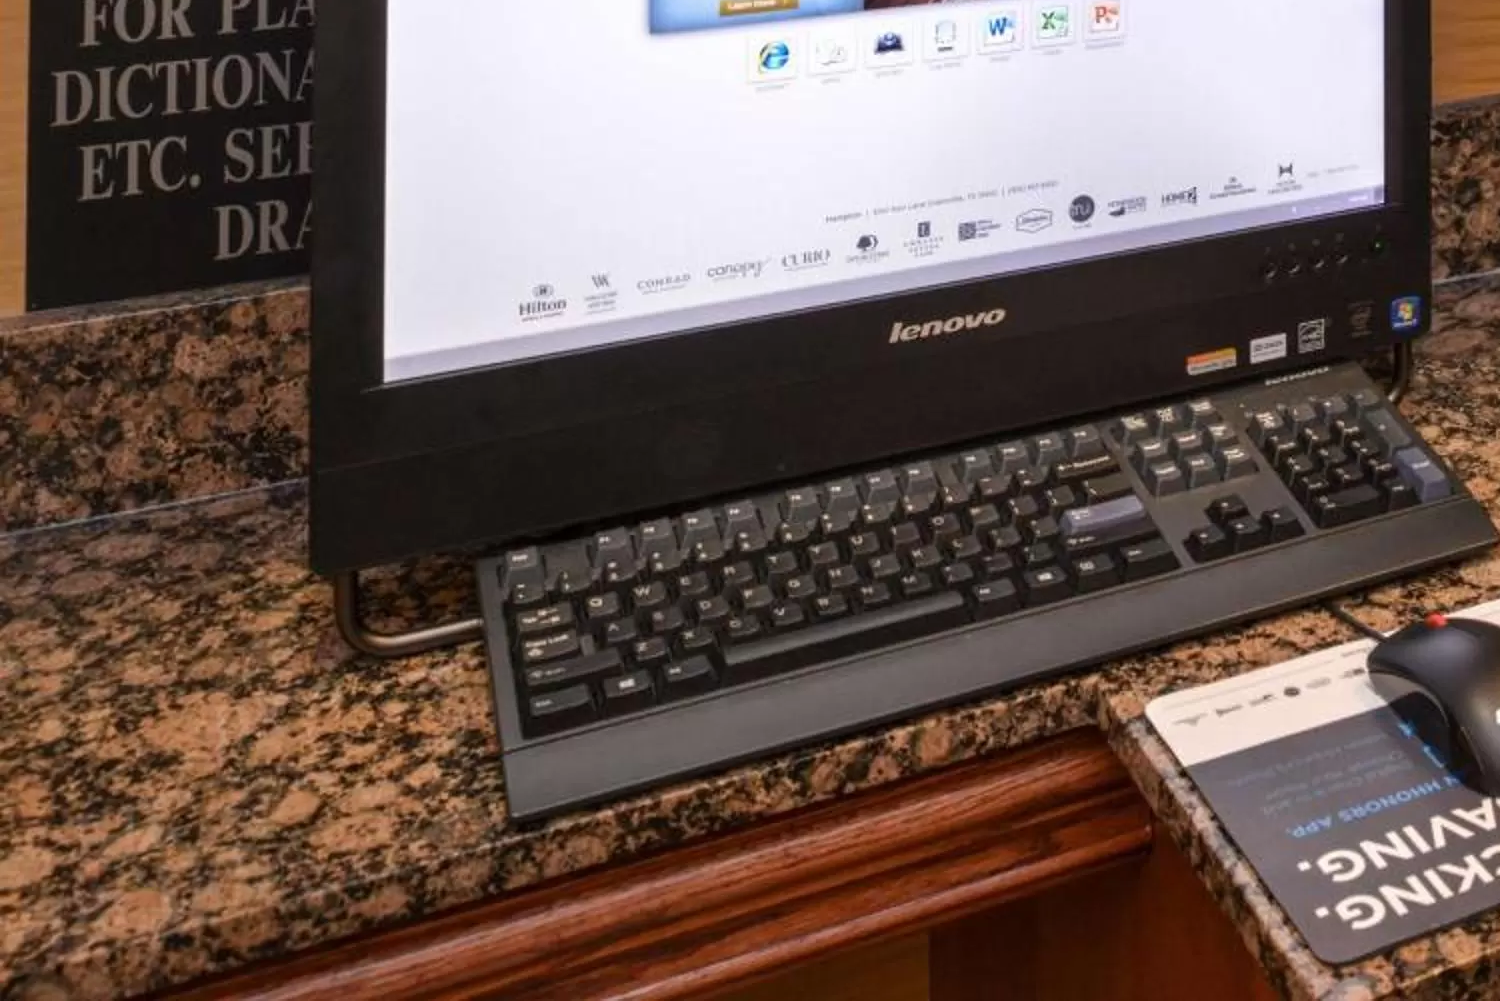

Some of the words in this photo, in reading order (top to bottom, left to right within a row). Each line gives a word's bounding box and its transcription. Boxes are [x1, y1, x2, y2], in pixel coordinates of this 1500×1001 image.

[77, 134, 201, 202] ETC.
[636, 273, 692, 291] CONRAD
[707, 261, 763, 279] canopy
[518, 298, 568, 317] Hilton
[888, 307, 1007, 344] lenovo
[1337, 778, 1441, 823] HHONORS
